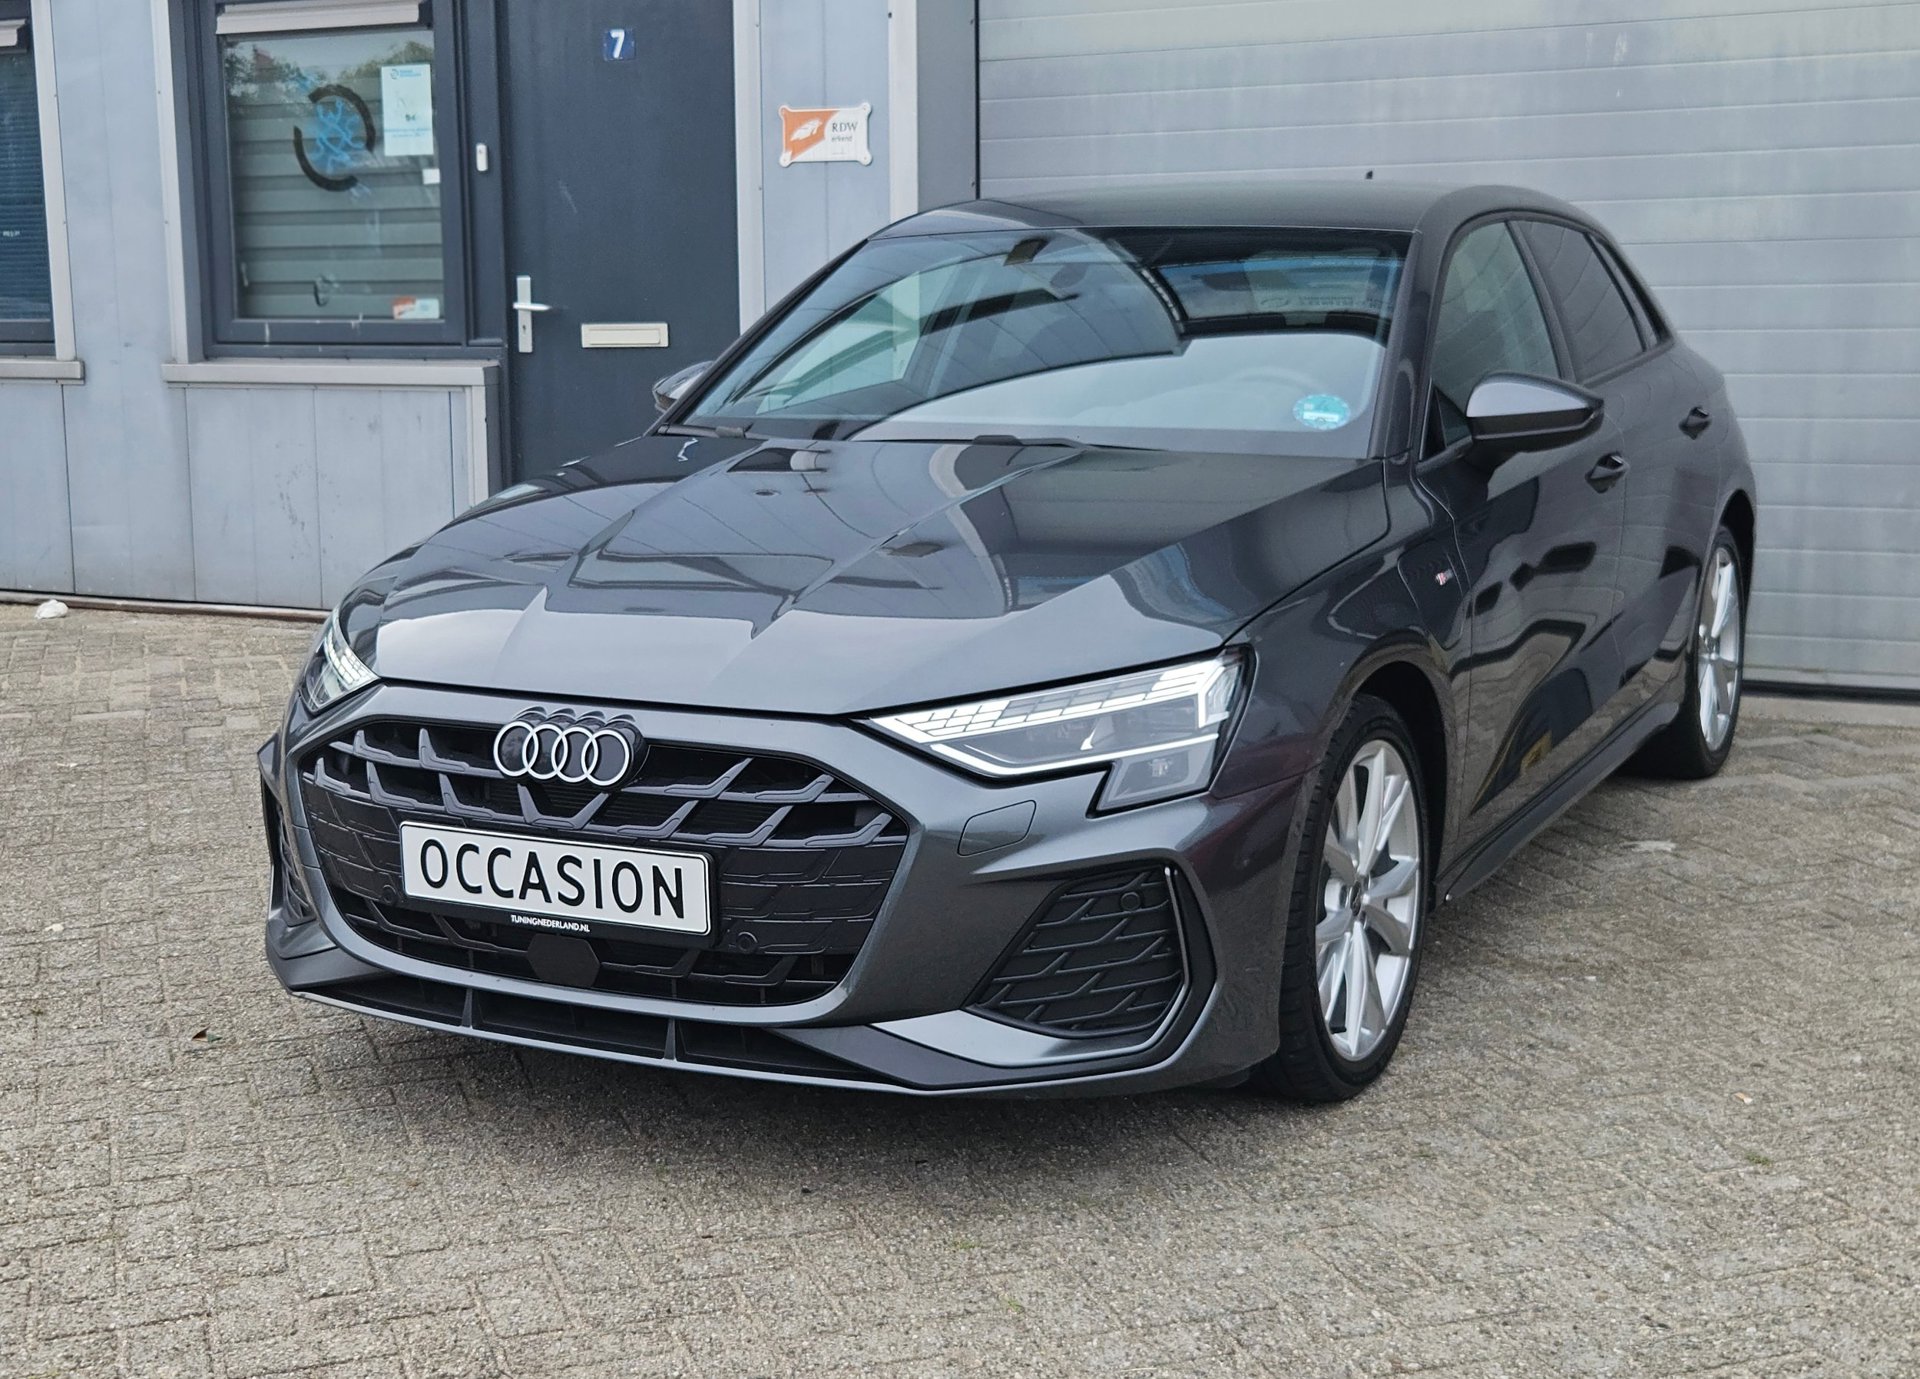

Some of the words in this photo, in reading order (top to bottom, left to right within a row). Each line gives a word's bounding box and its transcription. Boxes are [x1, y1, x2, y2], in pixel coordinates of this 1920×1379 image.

[609, 29, 626, 59] 7
[831, 121, 858, 132] RDW
[420, 838, 685, 919] OCCASION
[510, 914, 591, 933] TUNINGNEDERLAND.NL
